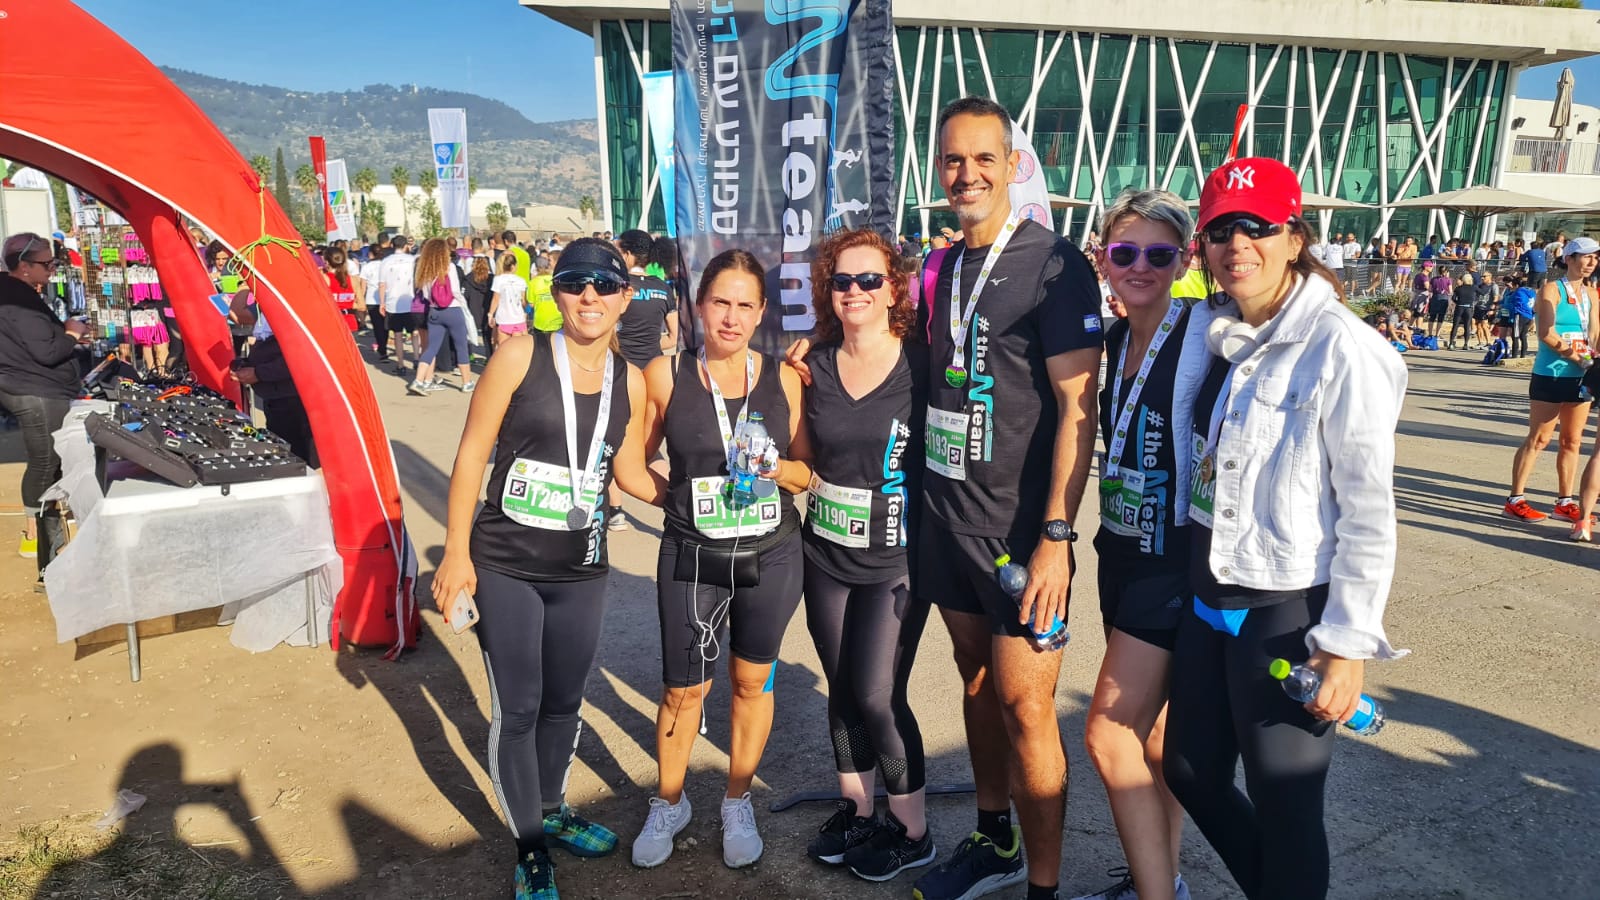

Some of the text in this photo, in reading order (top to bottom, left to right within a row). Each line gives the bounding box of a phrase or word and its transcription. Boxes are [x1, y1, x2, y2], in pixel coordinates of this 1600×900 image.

[697, 24, 707, 58] אישיים
[698, 61, 709, 97] אימונים
[712, 54, 740, 108] עם
[697, 133, 708, 166] קבוצת
[711, 120, 740, 235] ספורט
[1226, 166, 1255, 189] NY
[928, 431, 947, 457] 1193
[818, 501, 847, 529] 1190
